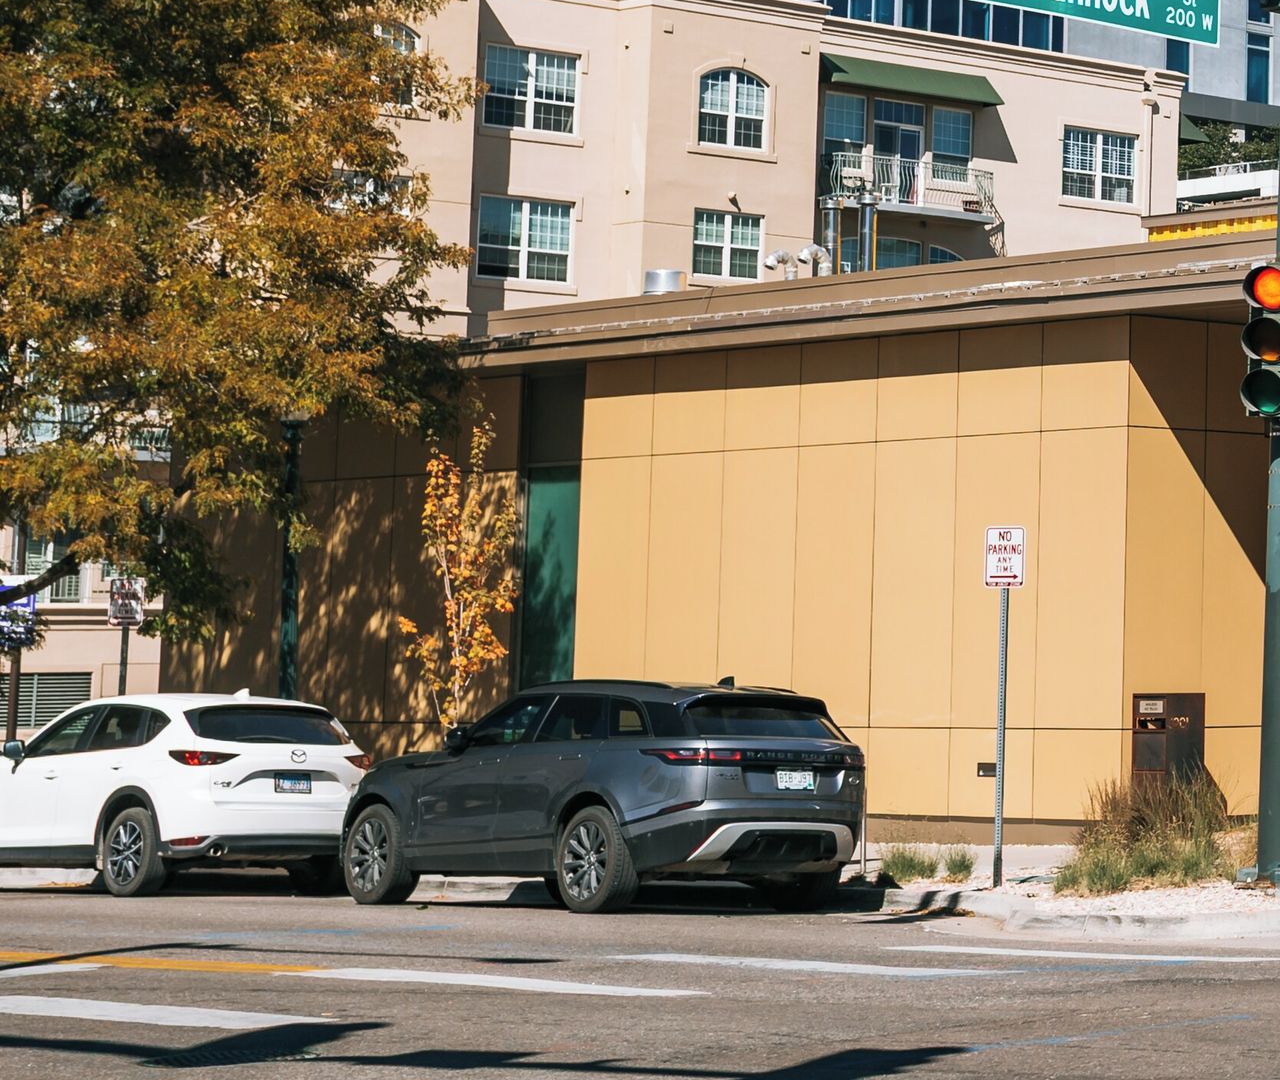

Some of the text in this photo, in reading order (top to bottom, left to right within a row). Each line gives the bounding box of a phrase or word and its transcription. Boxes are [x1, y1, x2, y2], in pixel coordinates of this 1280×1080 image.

[1165, 7, 1213, 30] 200 W
[999, 531, 1012, 542] NO
[988, 544, 1022, 555] PARKING
[996, 565, 1013, 573] TIME
[746, 751, 841, 761] RANGE ROVER
